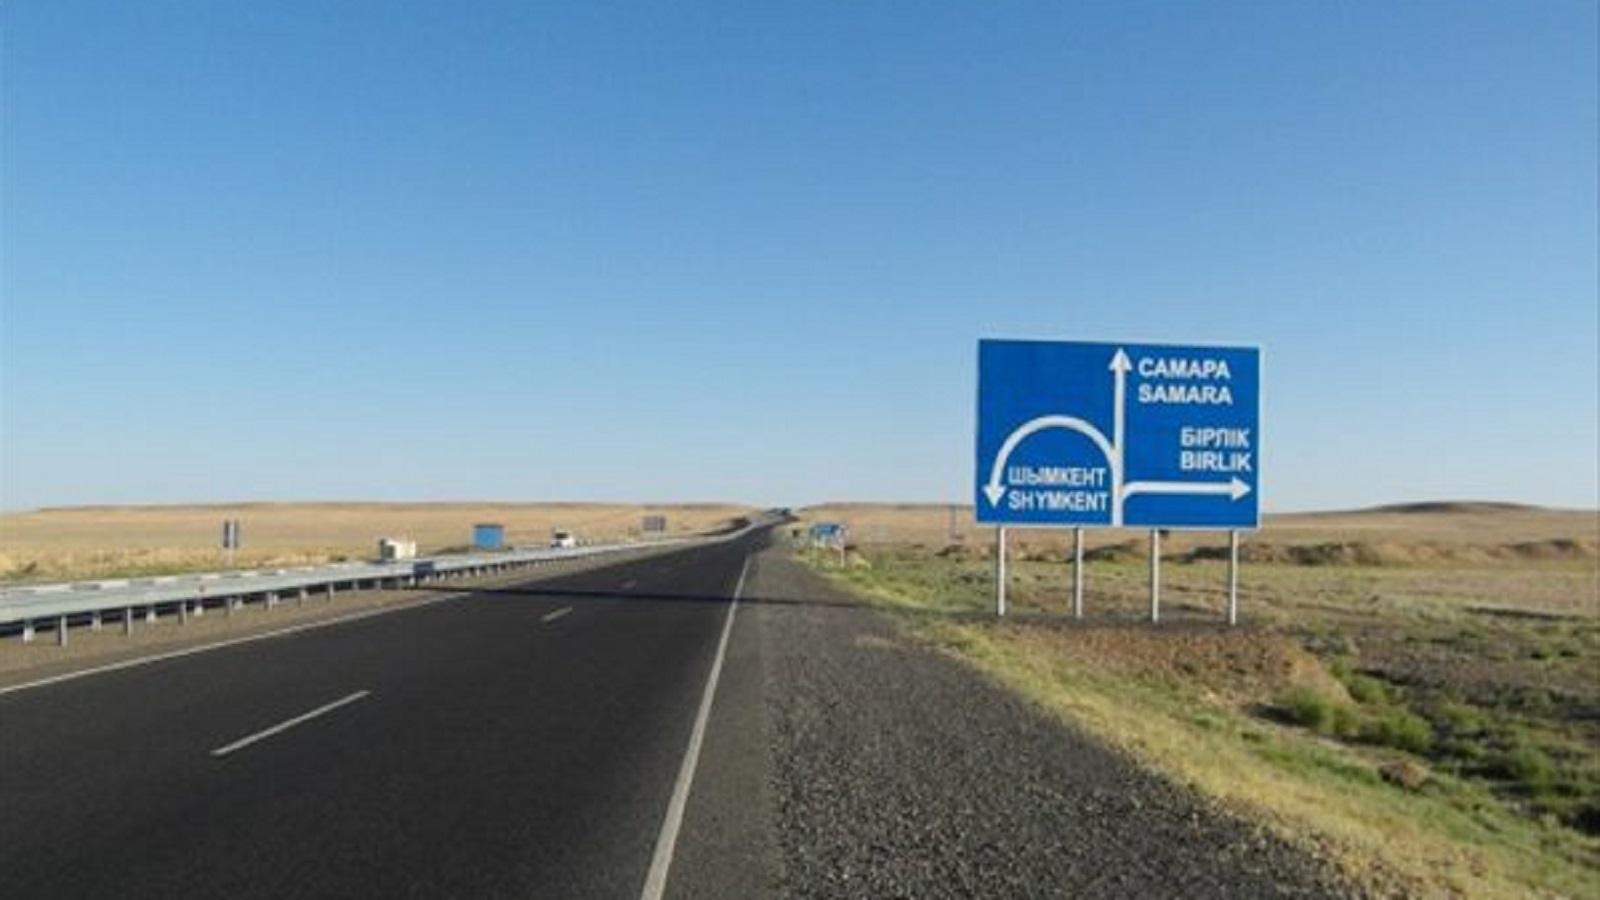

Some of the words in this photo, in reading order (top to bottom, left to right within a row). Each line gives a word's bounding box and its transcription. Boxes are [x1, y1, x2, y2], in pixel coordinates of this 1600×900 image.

[1138, 358, 1231, 379] САМАРА
[1138, 384, 1233, 405] SAMARA
[1180, 428, 1250, 449] БІРЛІК
[1180, 451, 1252, 472] BIRLIK
[1008, 466, 1107, 486] ШЫМКЕНТ
[1008, 491, 1109, 511] SHYMKENT
